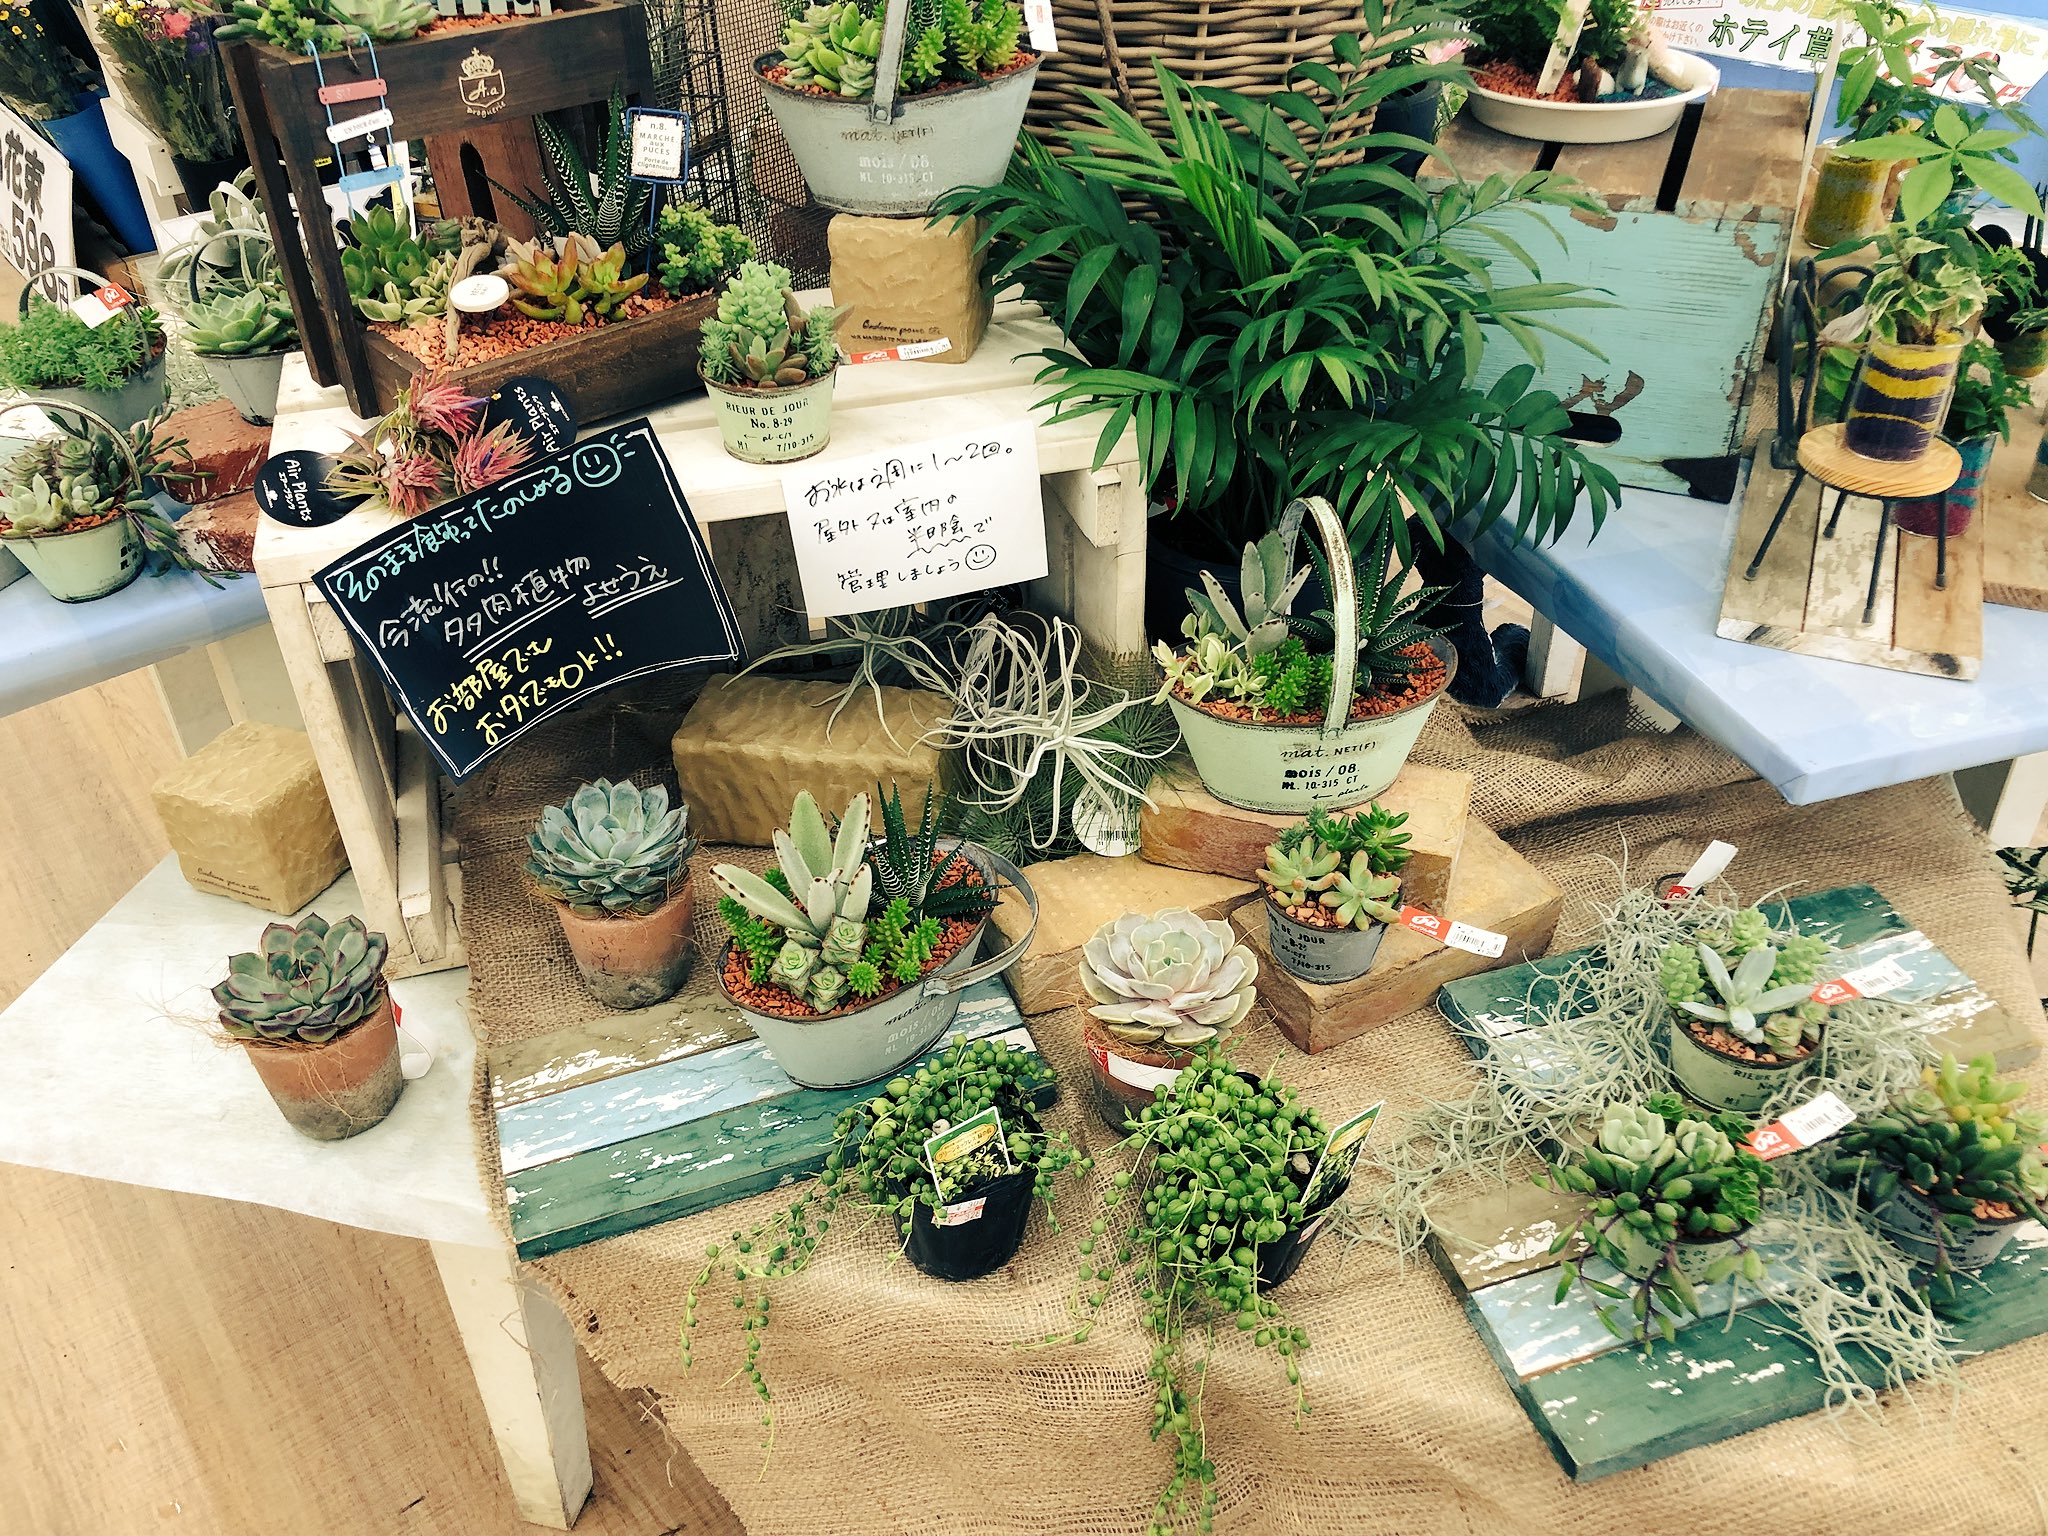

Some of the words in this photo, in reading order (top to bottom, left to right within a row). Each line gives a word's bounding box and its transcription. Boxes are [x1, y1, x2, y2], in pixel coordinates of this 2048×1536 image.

[1708, 13, 1834, 67] ホテイ草
[642, 146, 670, 156] PUCES
[859, 152, 894, 169] mois
[0, 128, 45, 222] 花束
[513, 385, 544, 432] Plants
[725, 401, 756, 416] RIEUR
[761, 406, 776, 416] DE
[782, 397, 809, 414] JOUR
[750, 418, 770, 430] No.
[540, 427, 562, 453] Air
[285, 458, 300, 481] Air
[292, 482, 313, 522] Plants
[906, 514, 993, 552] 半日陰で
[836, 557, 961, 595] 管理しましょう
[443, 554, 591, 648] 多肉植物
[426, 636, 553, 736] お部屋でも
[1280, 745, 1329, 758] mat.
[1334, 740, 1377, 756] NET(F)
[1284, 765, 1322, 779] mois
[1346, 774, 1359, 785] CT
[1297, 933, 1326, 945] JOUR
